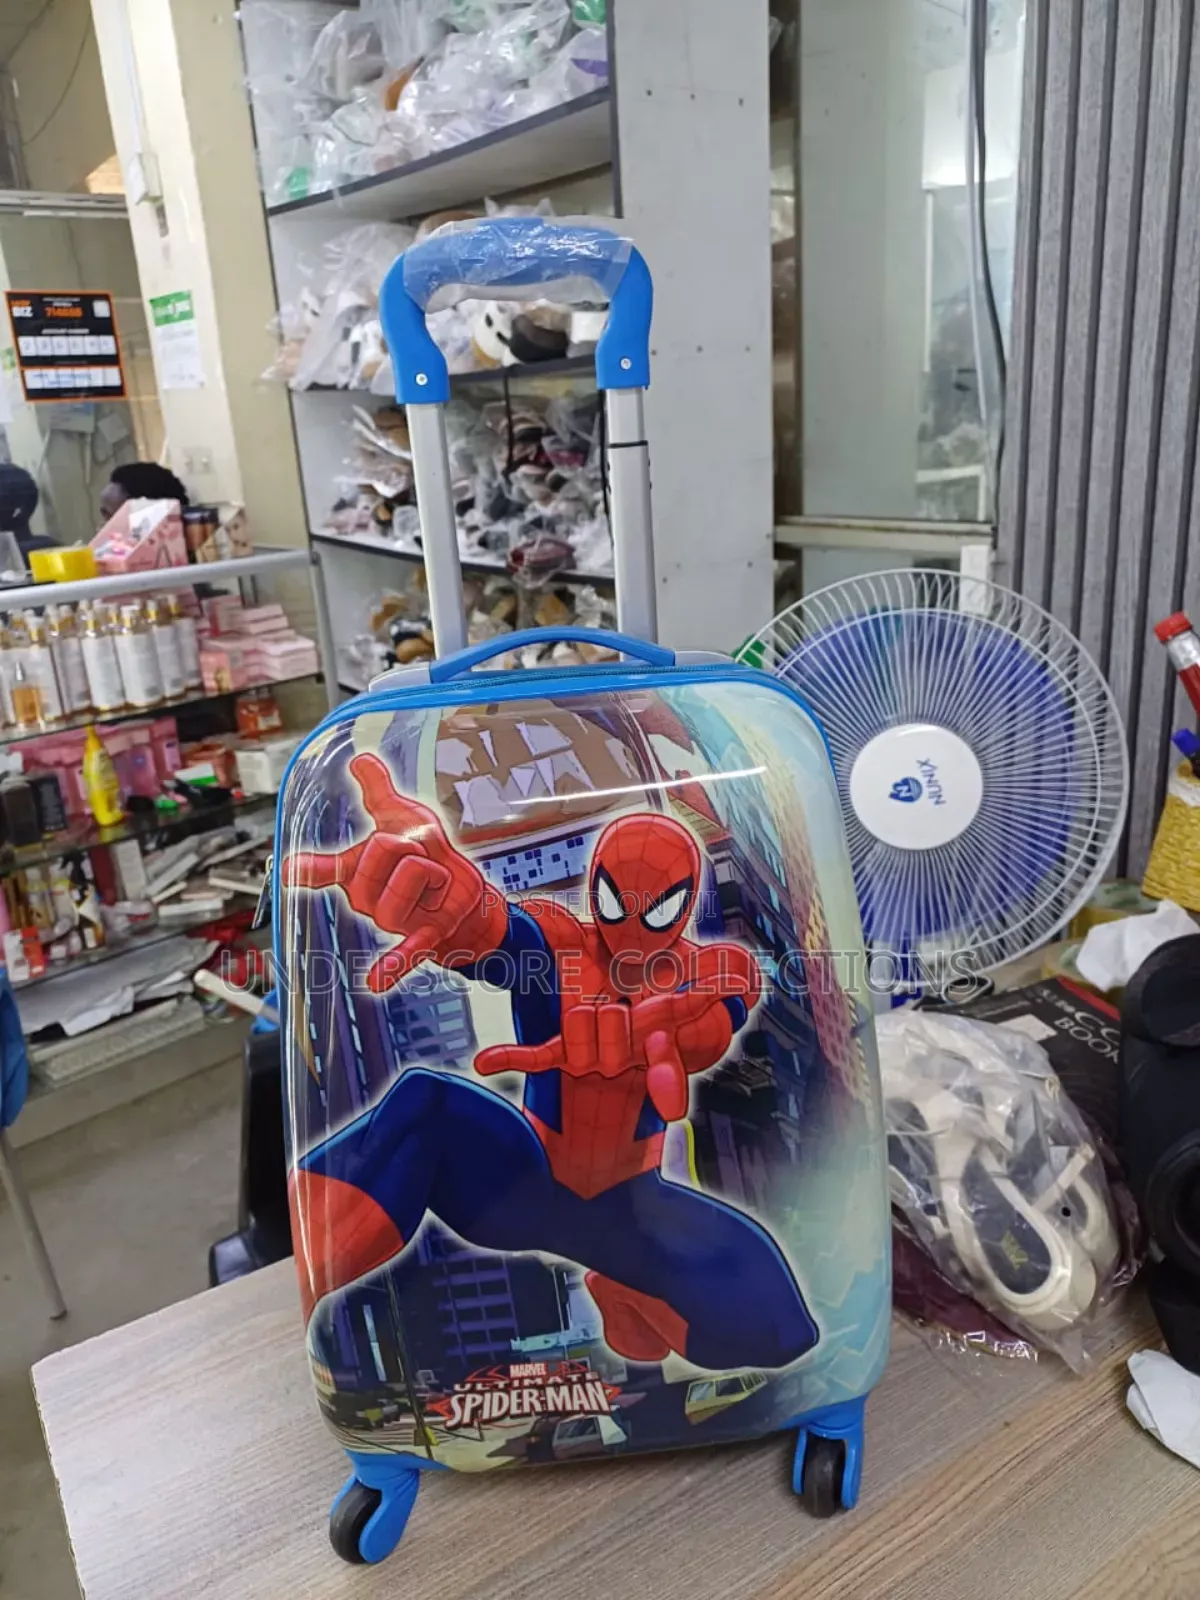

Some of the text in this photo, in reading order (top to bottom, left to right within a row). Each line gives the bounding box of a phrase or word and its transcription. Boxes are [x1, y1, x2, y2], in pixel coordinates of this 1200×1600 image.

[509, 1362, 547, 1378] MARVEL
[453, 1371, 600, 1392] ULTIMATE
[444, 1380, 612, 1429] SPIDER-MAN
